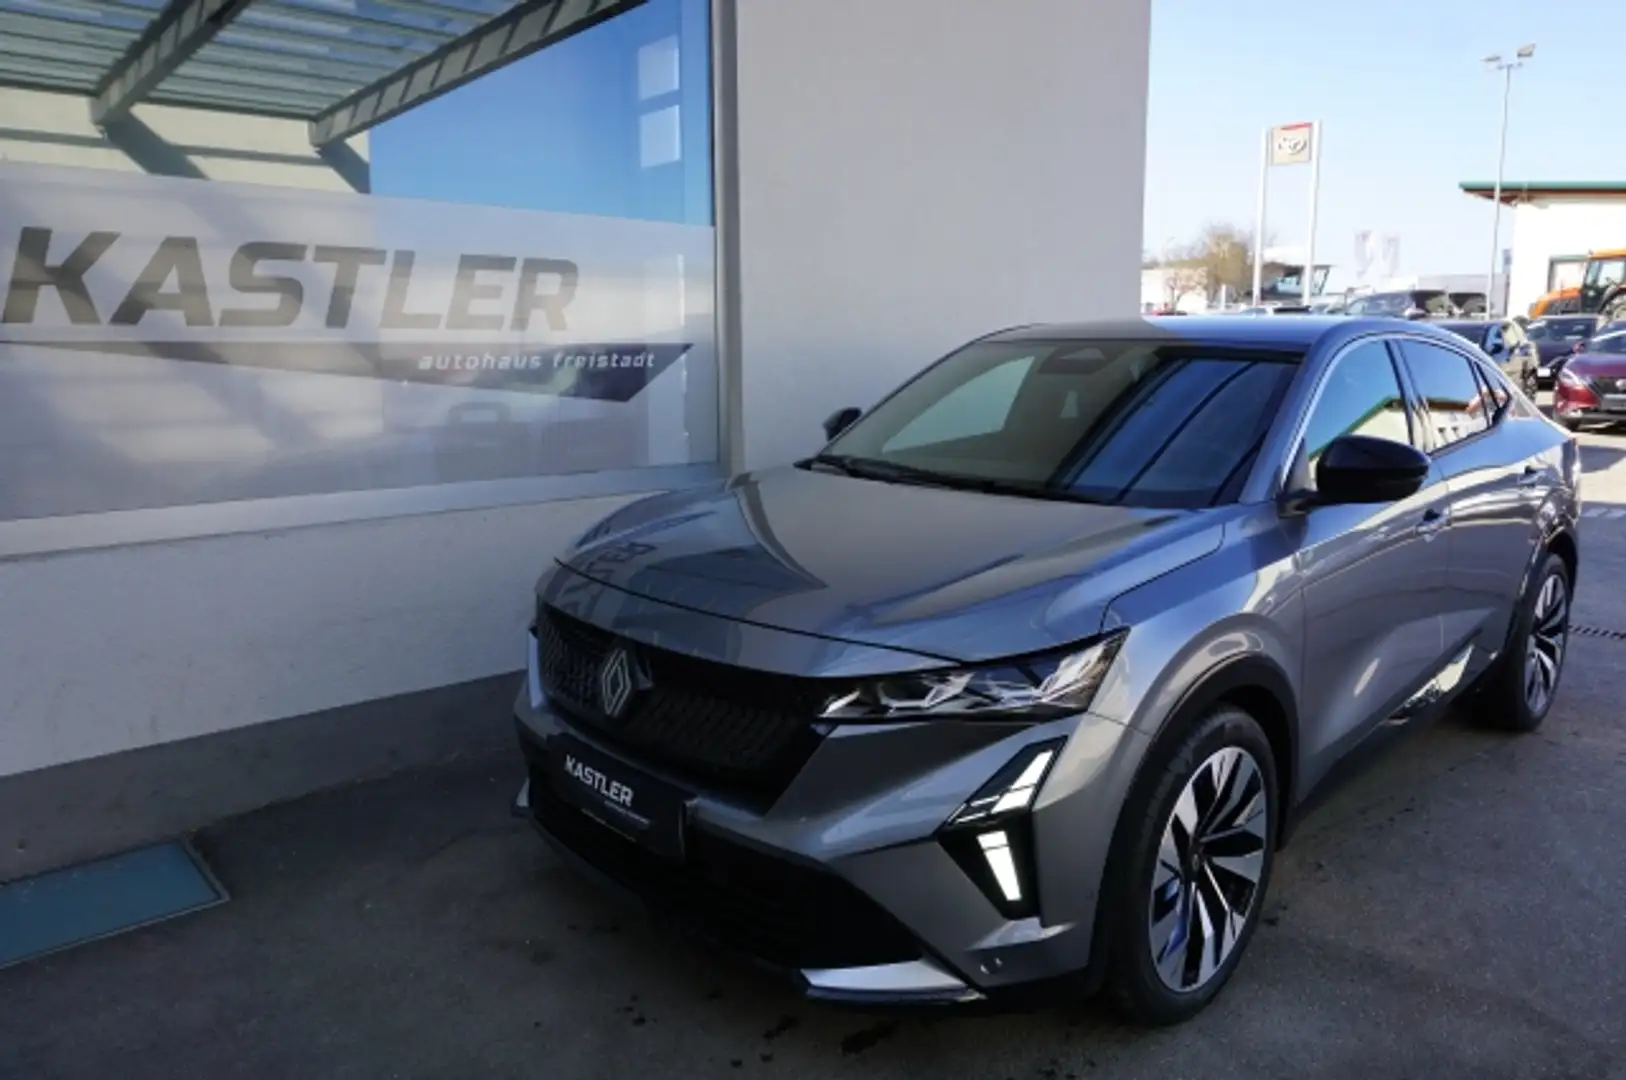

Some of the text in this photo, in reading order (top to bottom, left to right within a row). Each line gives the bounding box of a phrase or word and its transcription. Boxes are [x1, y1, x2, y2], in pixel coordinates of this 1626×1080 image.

[2, 226, 579, 331] KASTLER
[418, 350, 656, 370] autohaus freistadt
[564, 754, 634, 806] KASTLER
